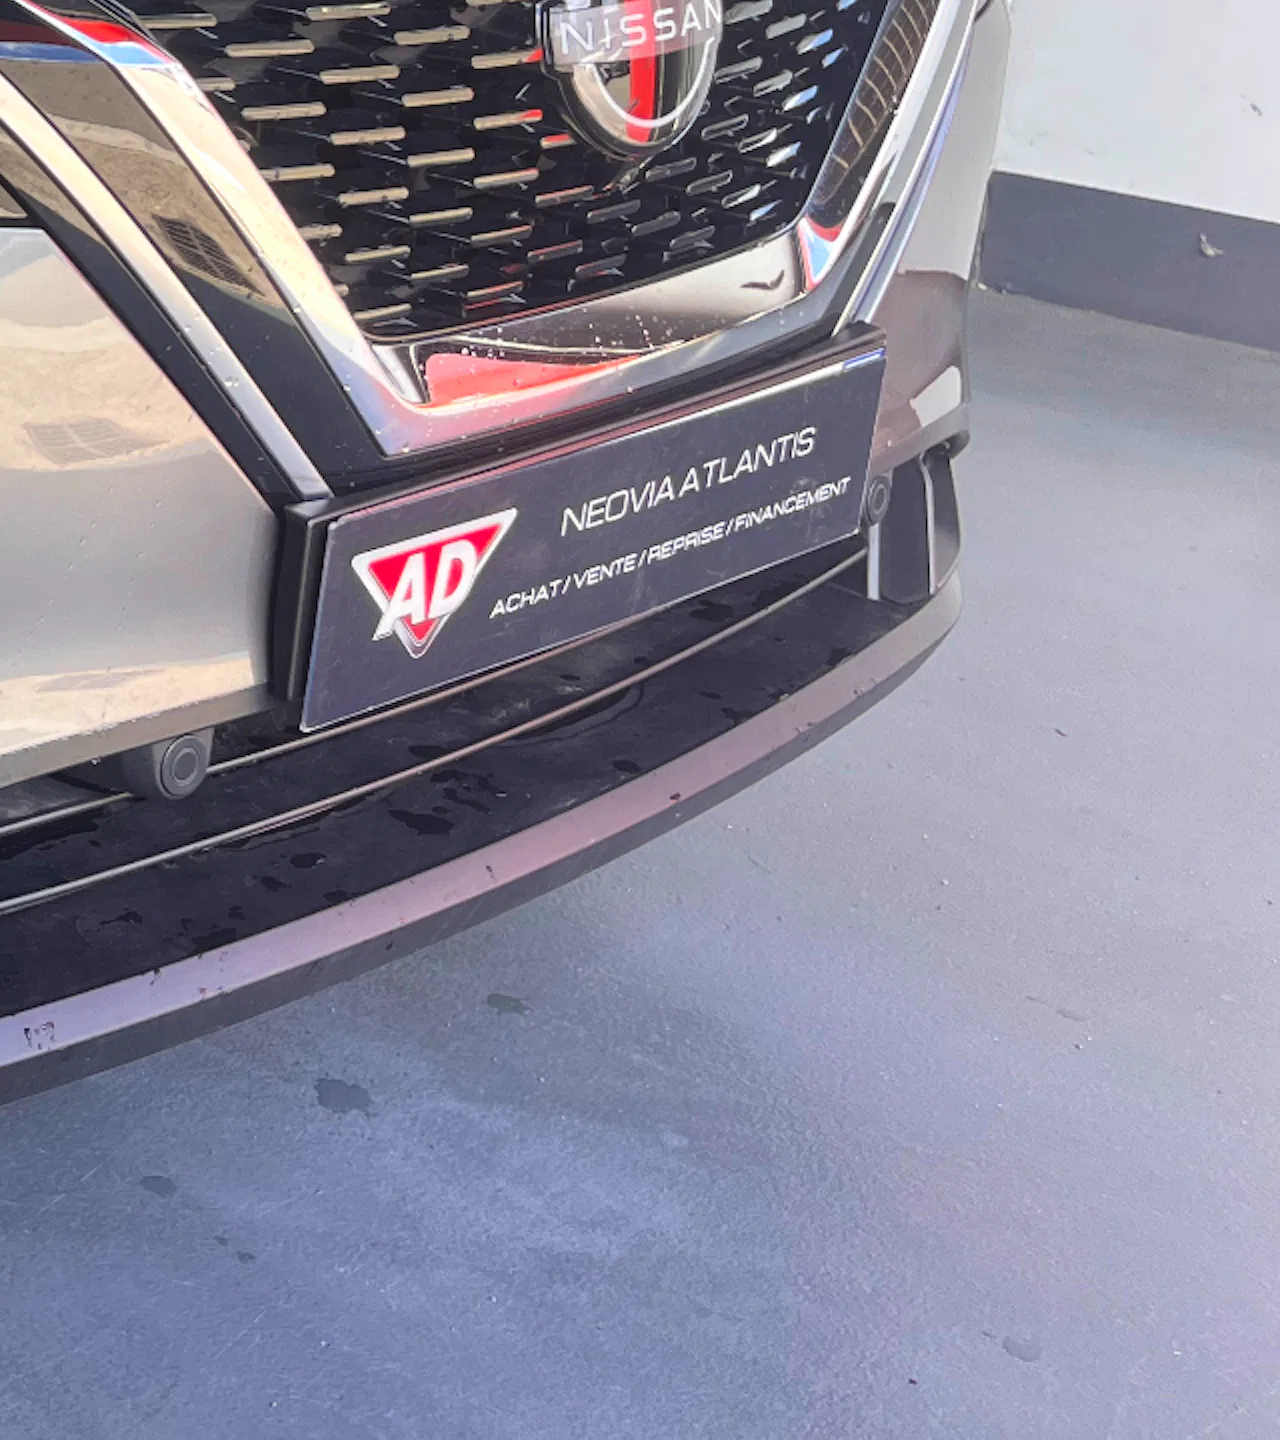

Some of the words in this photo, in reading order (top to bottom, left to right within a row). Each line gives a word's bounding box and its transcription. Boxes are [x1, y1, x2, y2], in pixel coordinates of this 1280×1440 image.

[561, 475, 676, 537] NEOVIA
[679, 427, 816, 497] ATLANTIS
[372, 538, 477, 640] AD
[489, 578, 563, 619] ACHAT
[734, 476, 851, 533] FINANCEMENT
